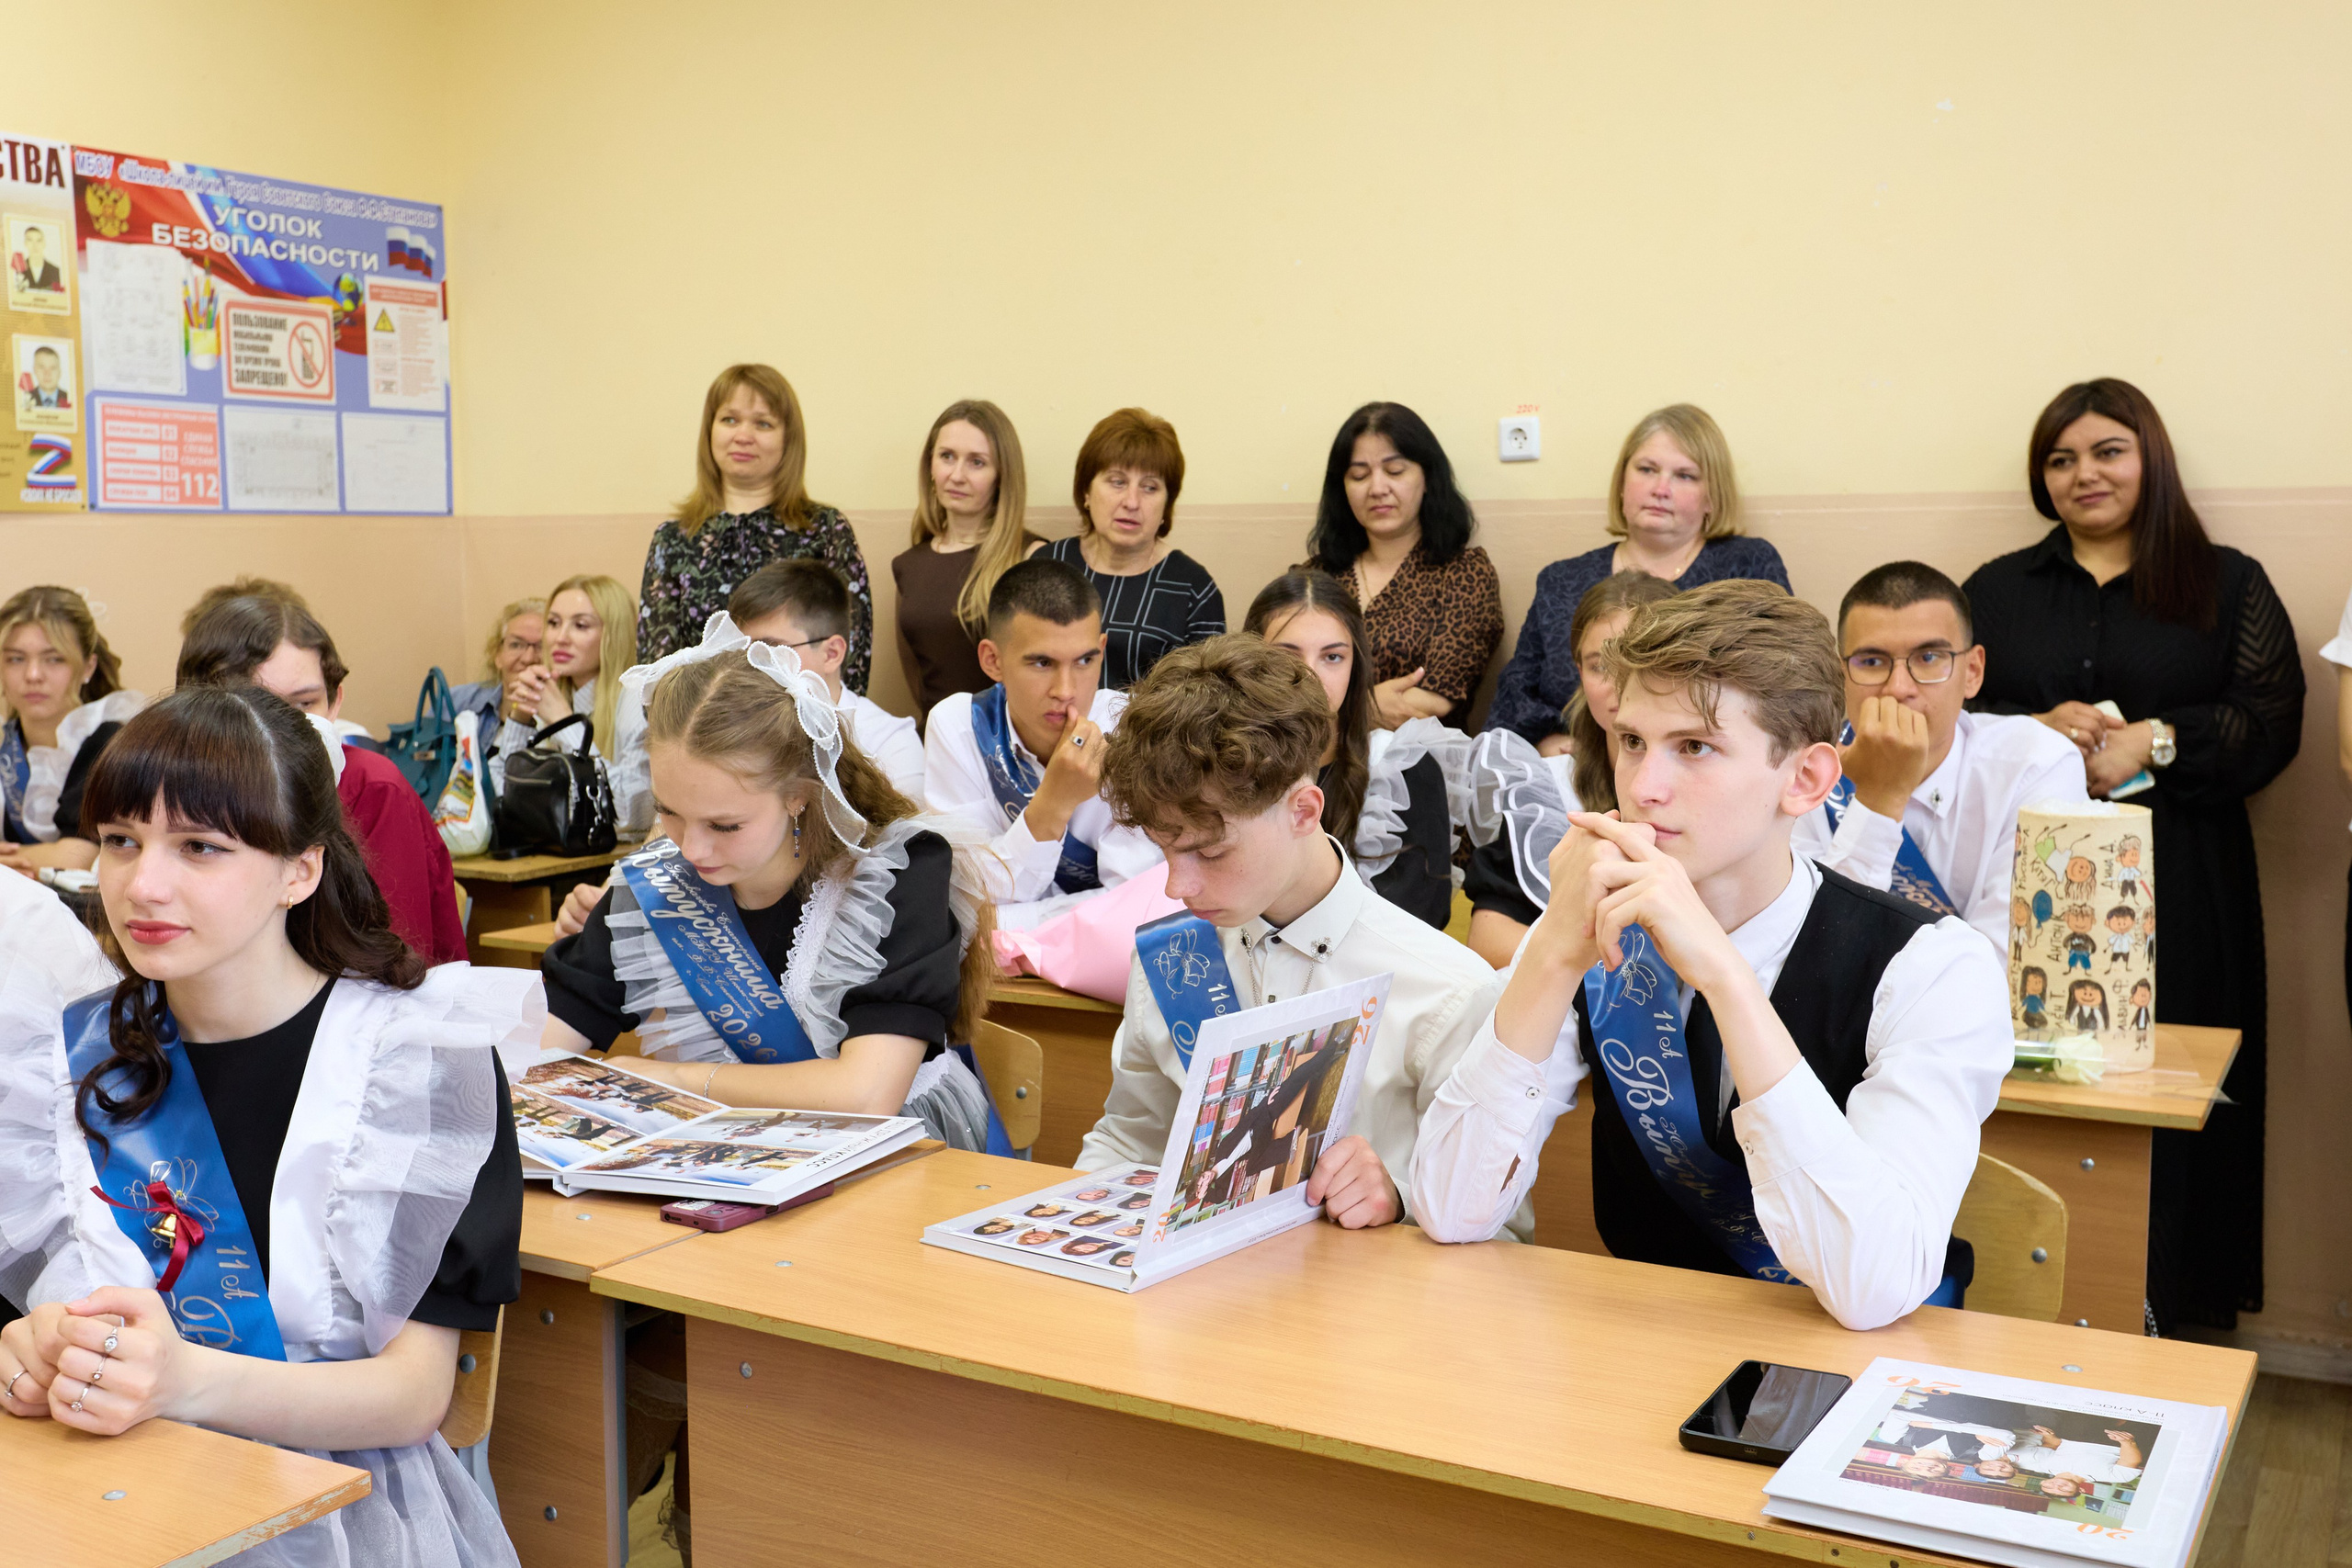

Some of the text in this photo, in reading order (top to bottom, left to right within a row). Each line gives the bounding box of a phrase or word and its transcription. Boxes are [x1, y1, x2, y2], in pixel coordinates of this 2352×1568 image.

[0, 140, 65, 188] ТВА
[213, 205, 322, 240] УГОЛОК
[152, 223, 379, 272] БЕЗОПАСНОСТИ
[182, 472, 218, 498] 112
[627, 840, 785, 1010] Выпускница
[717, 911, 763, 972] Екатерина
[707, 1003, 777, 1063] 2026
[1351, 996, 1377, 1045] 26
[1152, 1212, 1171, 1243] 20
[1886, 1375, 1962, 1397] 26
[2076, 1522, 2135, 1540] 20
